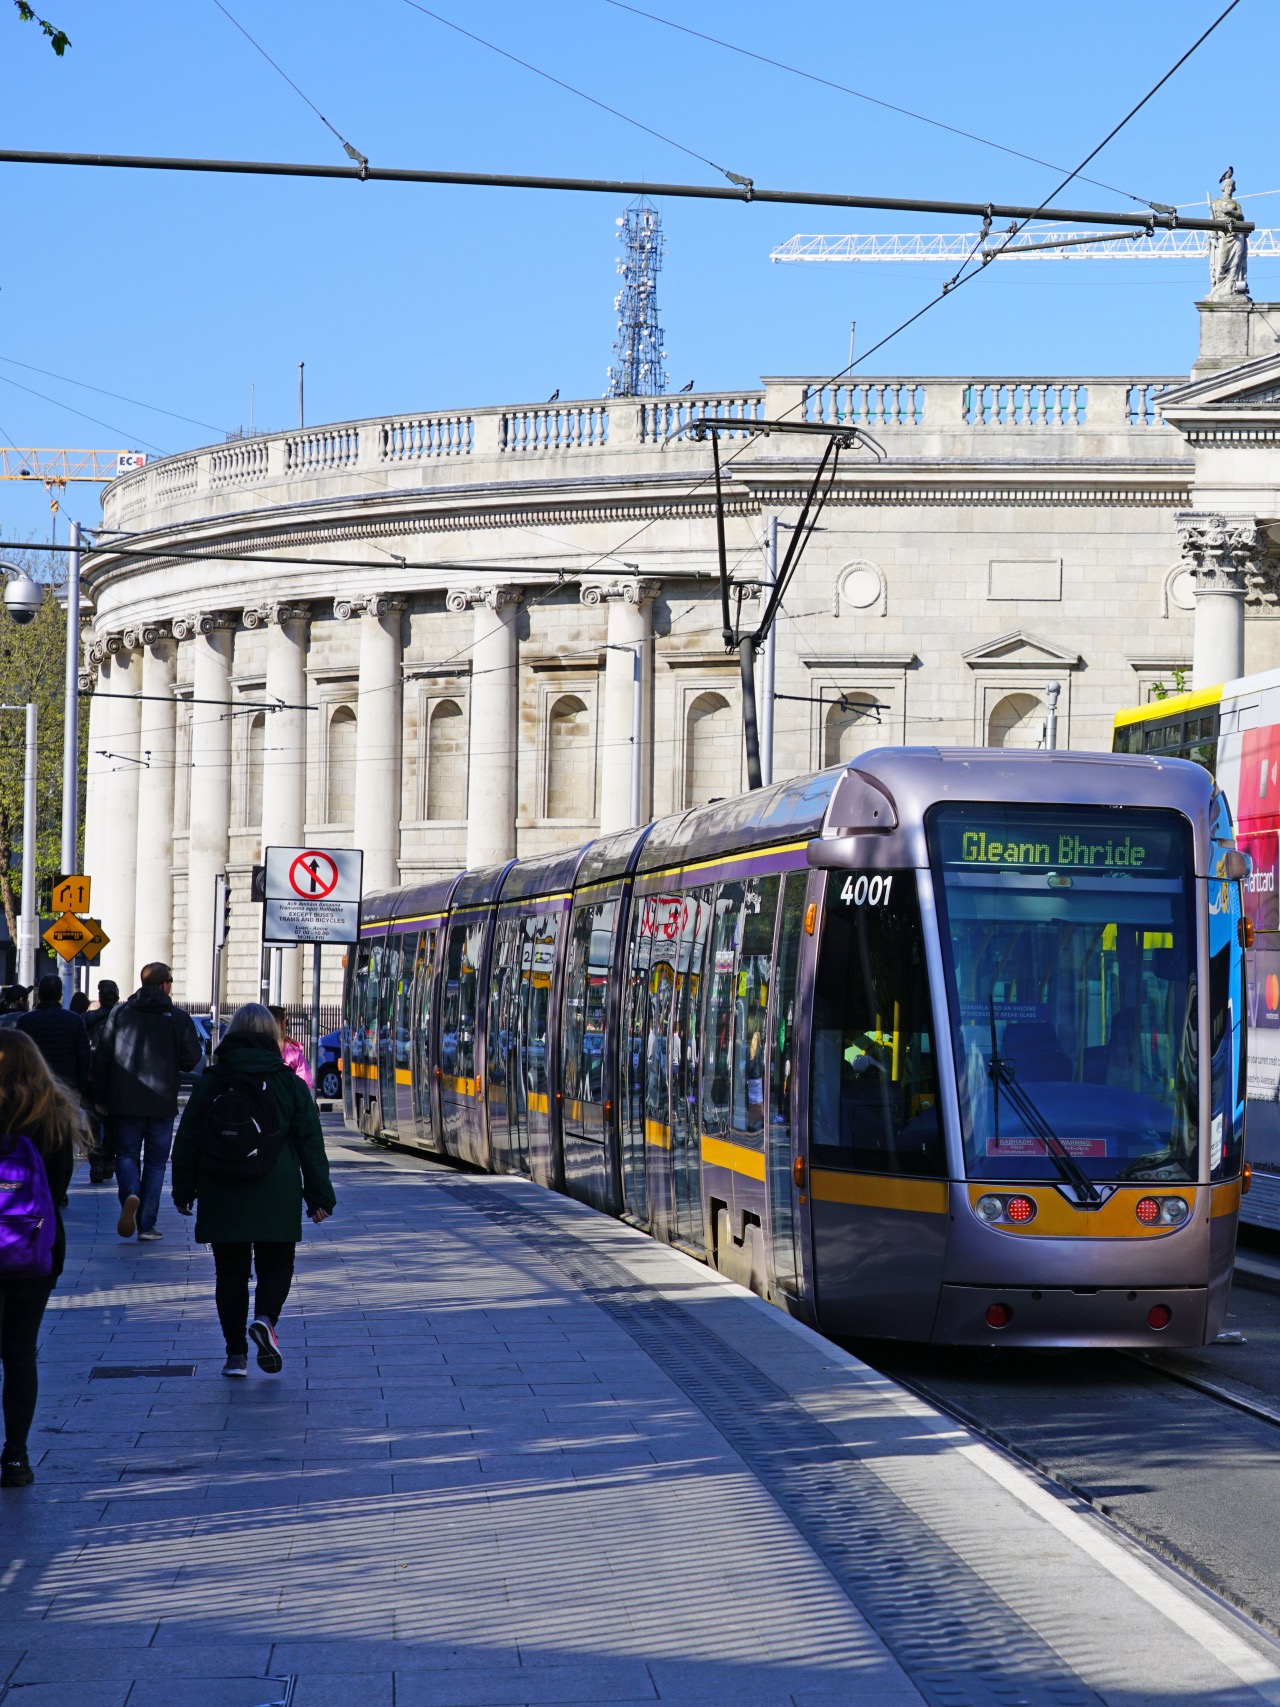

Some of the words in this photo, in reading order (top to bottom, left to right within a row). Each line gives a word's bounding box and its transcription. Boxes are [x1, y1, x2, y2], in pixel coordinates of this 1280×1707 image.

[120, 456, 144, 466] EC-B
[962, 832, 1050, 862] Gleann
[1058, 835, 1146, 866] Bhride
[840, 876, 893, 906] 4001
